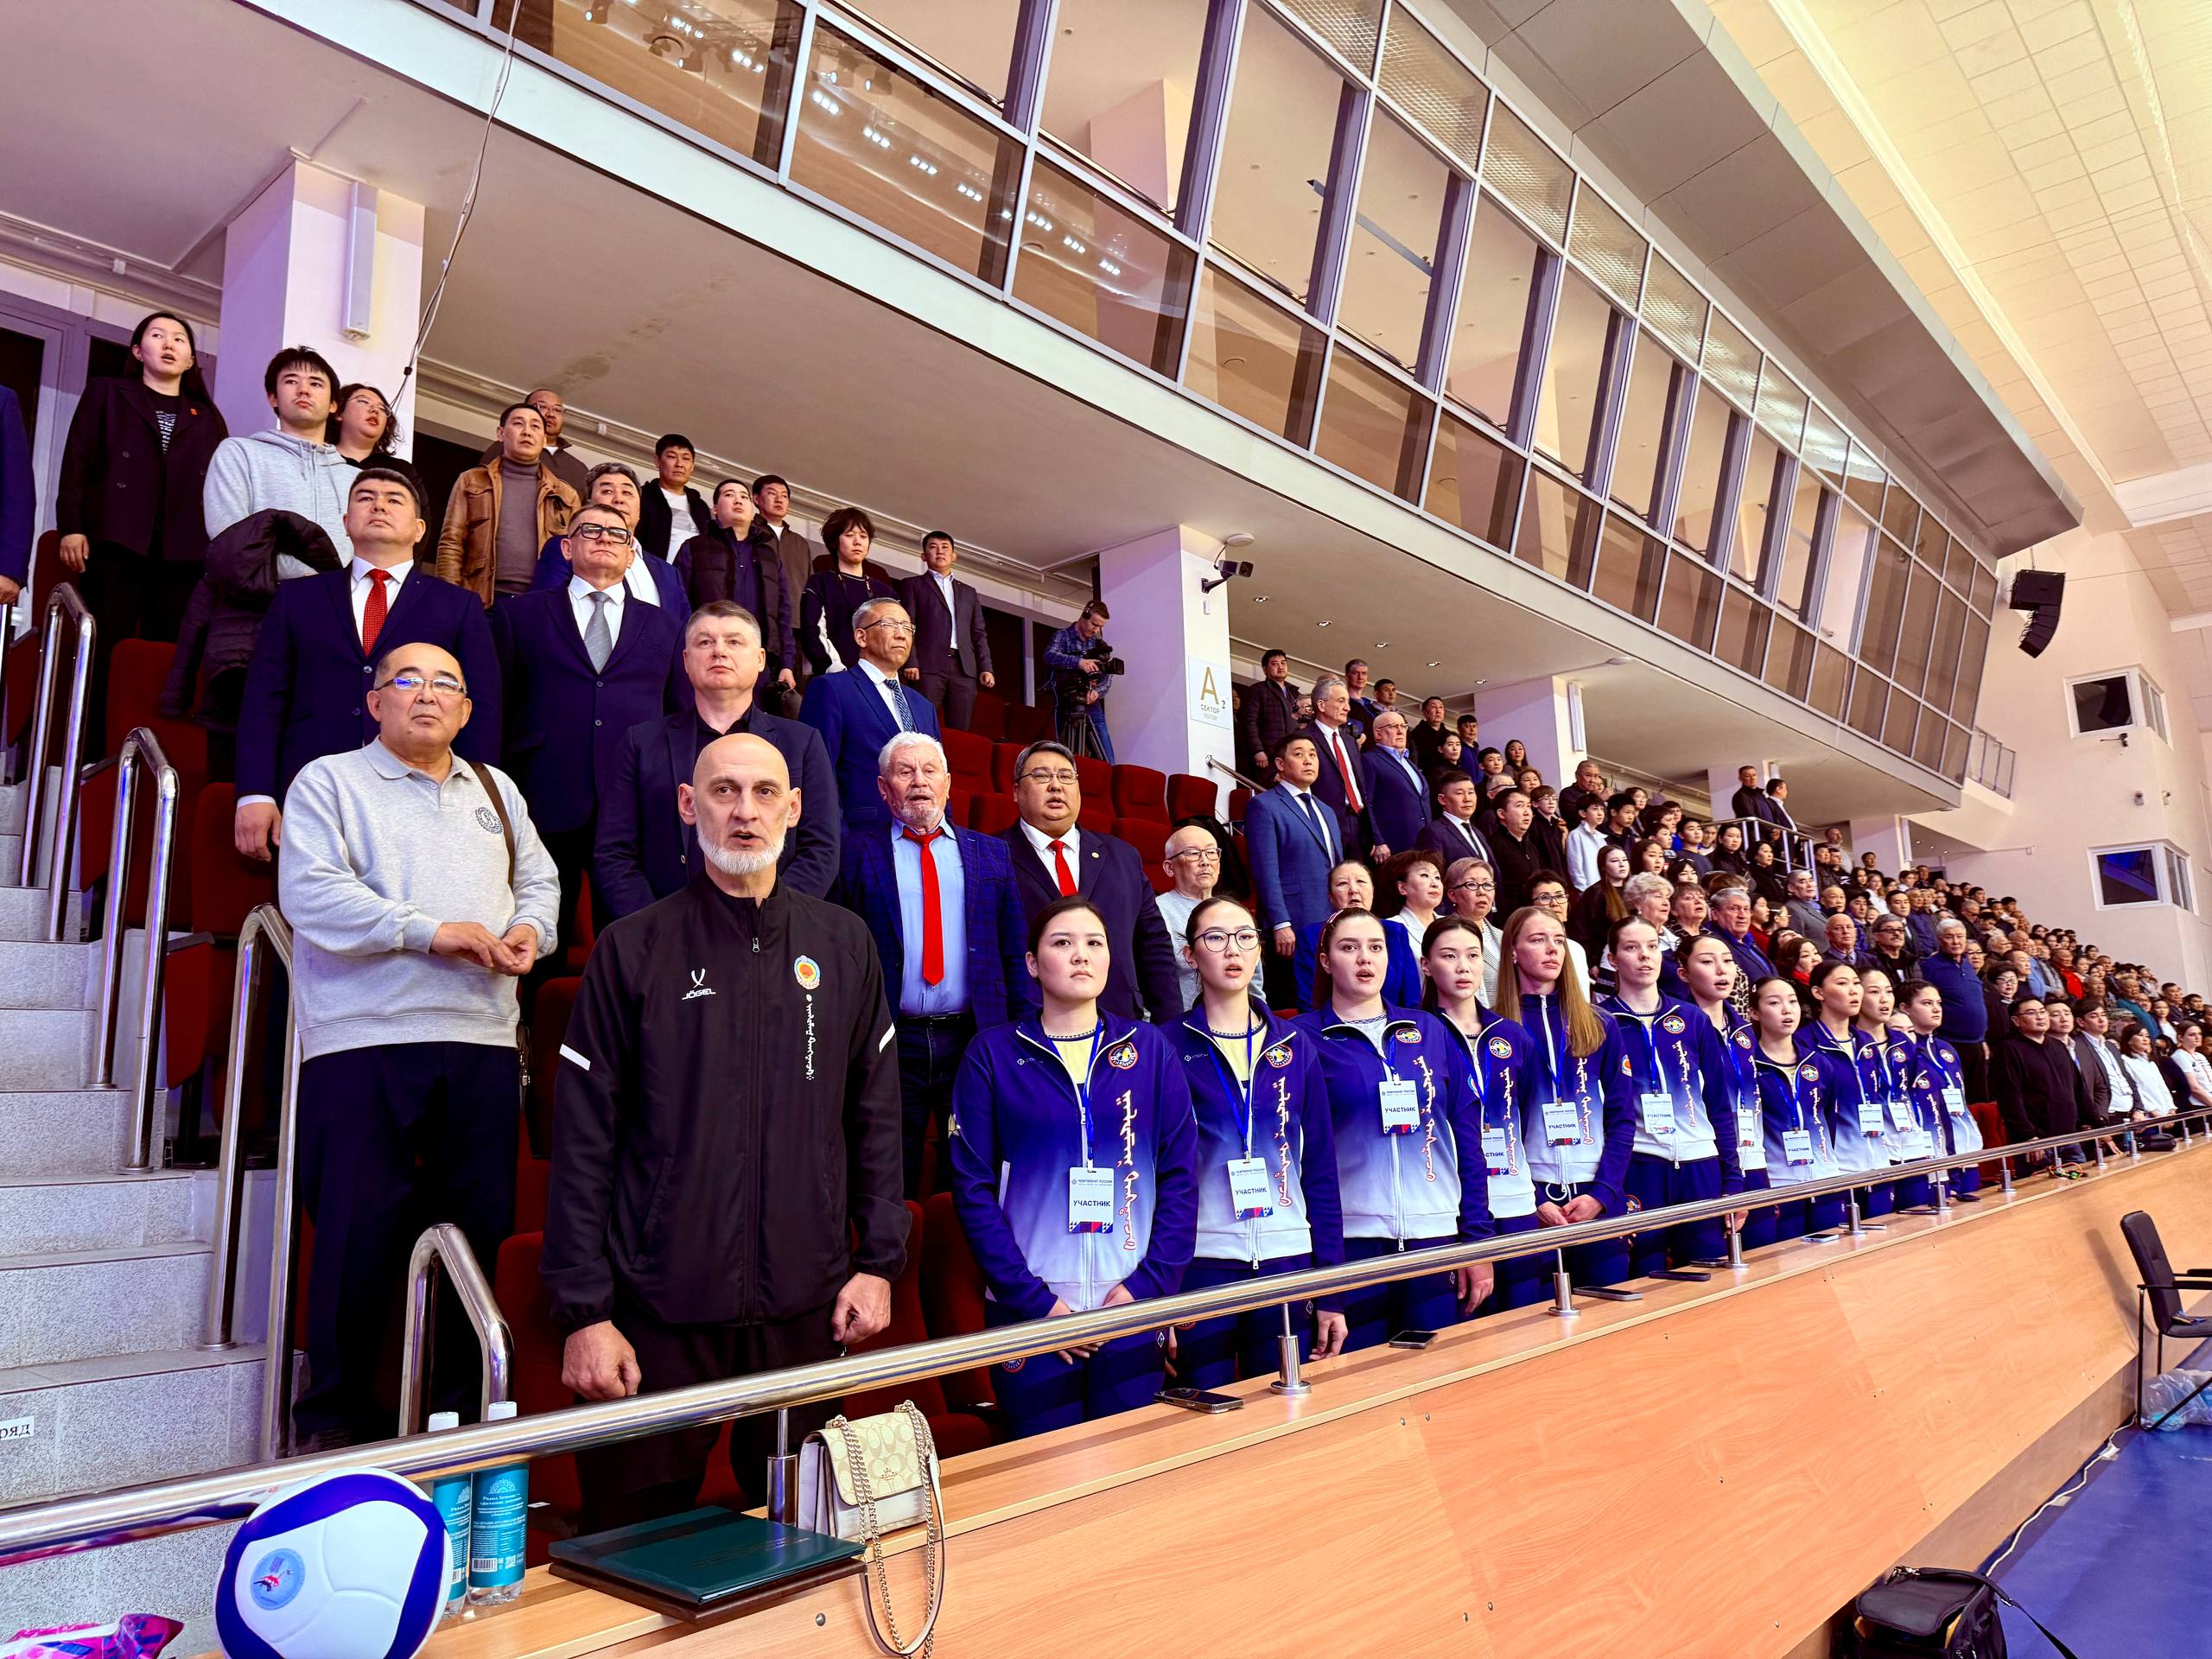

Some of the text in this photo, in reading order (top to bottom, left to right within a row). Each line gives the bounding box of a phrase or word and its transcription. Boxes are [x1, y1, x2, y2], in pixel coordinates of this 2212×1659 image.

[1200, 703, 1220, 715] СЕКТОР
[1221, 700, 1226, 709] 2
[682, 988, 716, 1001] JÖGEL
[1235, 1186, 1268, 1196] УЧАСТНИК
